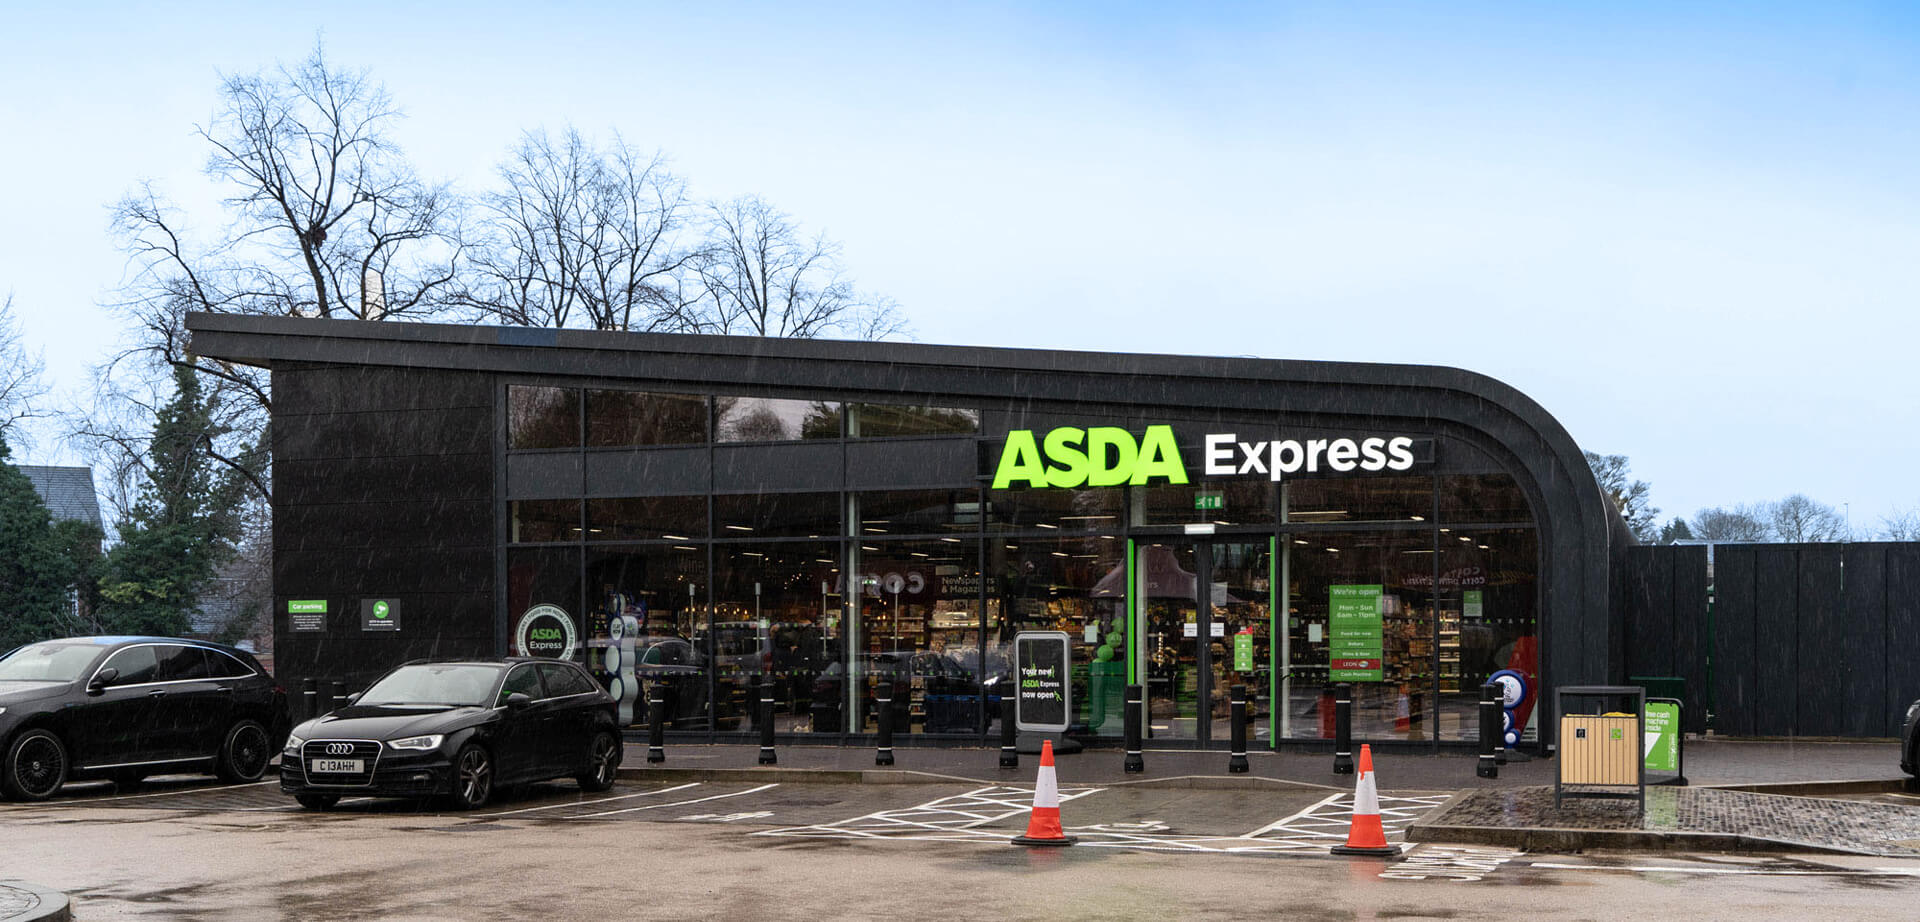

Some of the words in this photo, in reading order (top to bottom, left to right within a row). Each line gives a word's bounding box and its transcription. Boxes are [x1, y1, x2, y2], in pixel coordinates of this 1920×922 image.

[992, 425, 1189, 489] ASDA
[1205, 433, 1414, 482] Express
[1332, 588, 1357, 596] We're
[1359, 589, 1380, 598] open
[531, 629, 562, 640] ASDA
[530, 641, 562, 650] Express
[1022, 680, 1039, 688] ASDA
